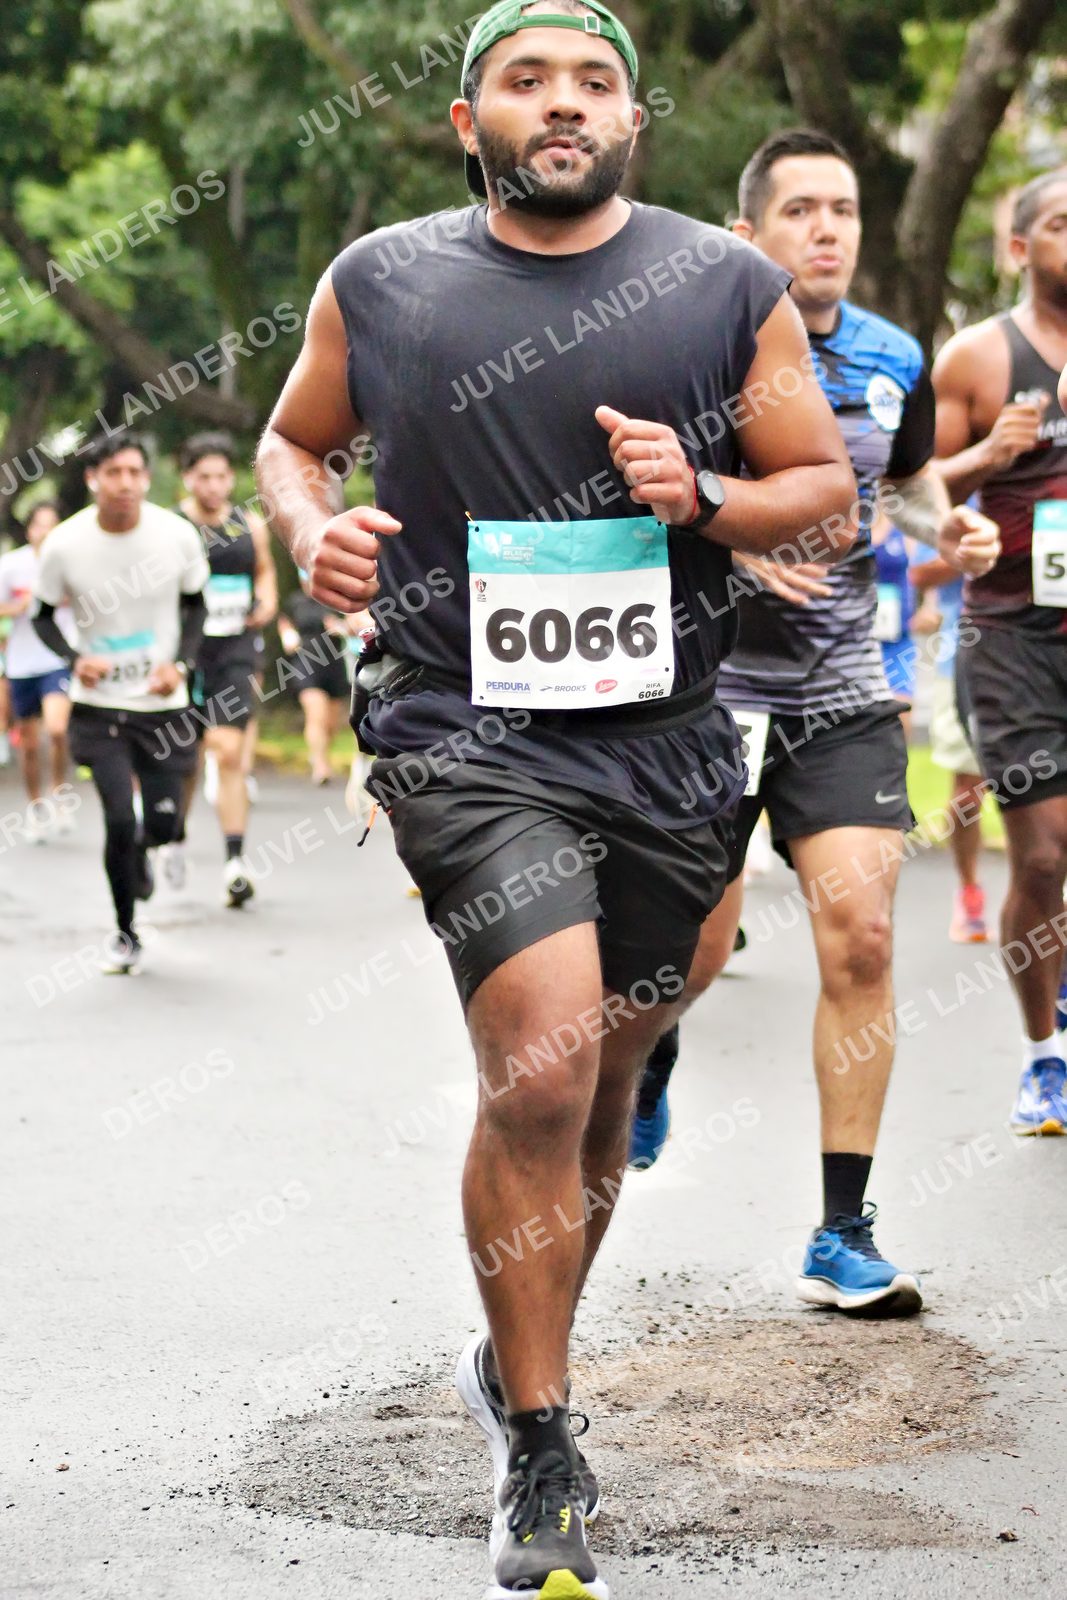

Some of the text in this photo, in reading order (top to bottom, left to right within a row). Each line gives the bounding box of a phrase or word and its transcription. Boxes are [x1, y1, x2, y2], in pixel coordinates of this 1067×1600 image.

[486, 603, 658, 664] 6066
[486, 681, 530, 691] PERDURA
[554, 684, 587, 692] BROOKS
[638, 689, 664, 699] 6066
